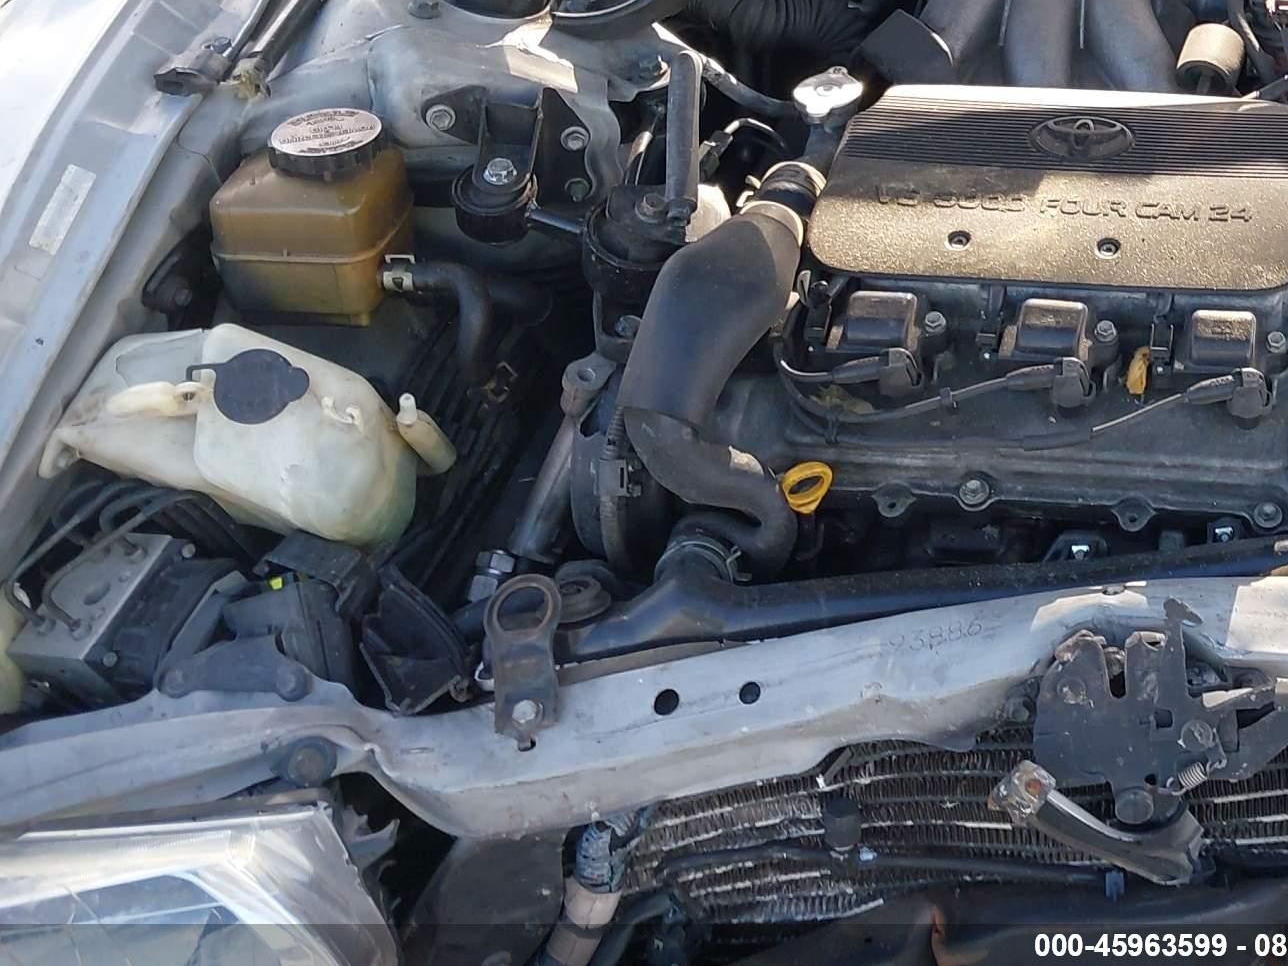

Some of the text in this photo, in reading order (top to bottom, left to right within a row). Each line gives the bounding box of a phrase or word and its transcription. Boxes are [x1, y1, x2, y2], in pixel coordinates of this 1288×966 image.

[1040, 198, 1127, 218] FOUR
[1135, 202, 1199, 221] CAM
[1208, 206, 1252, 223] 24
